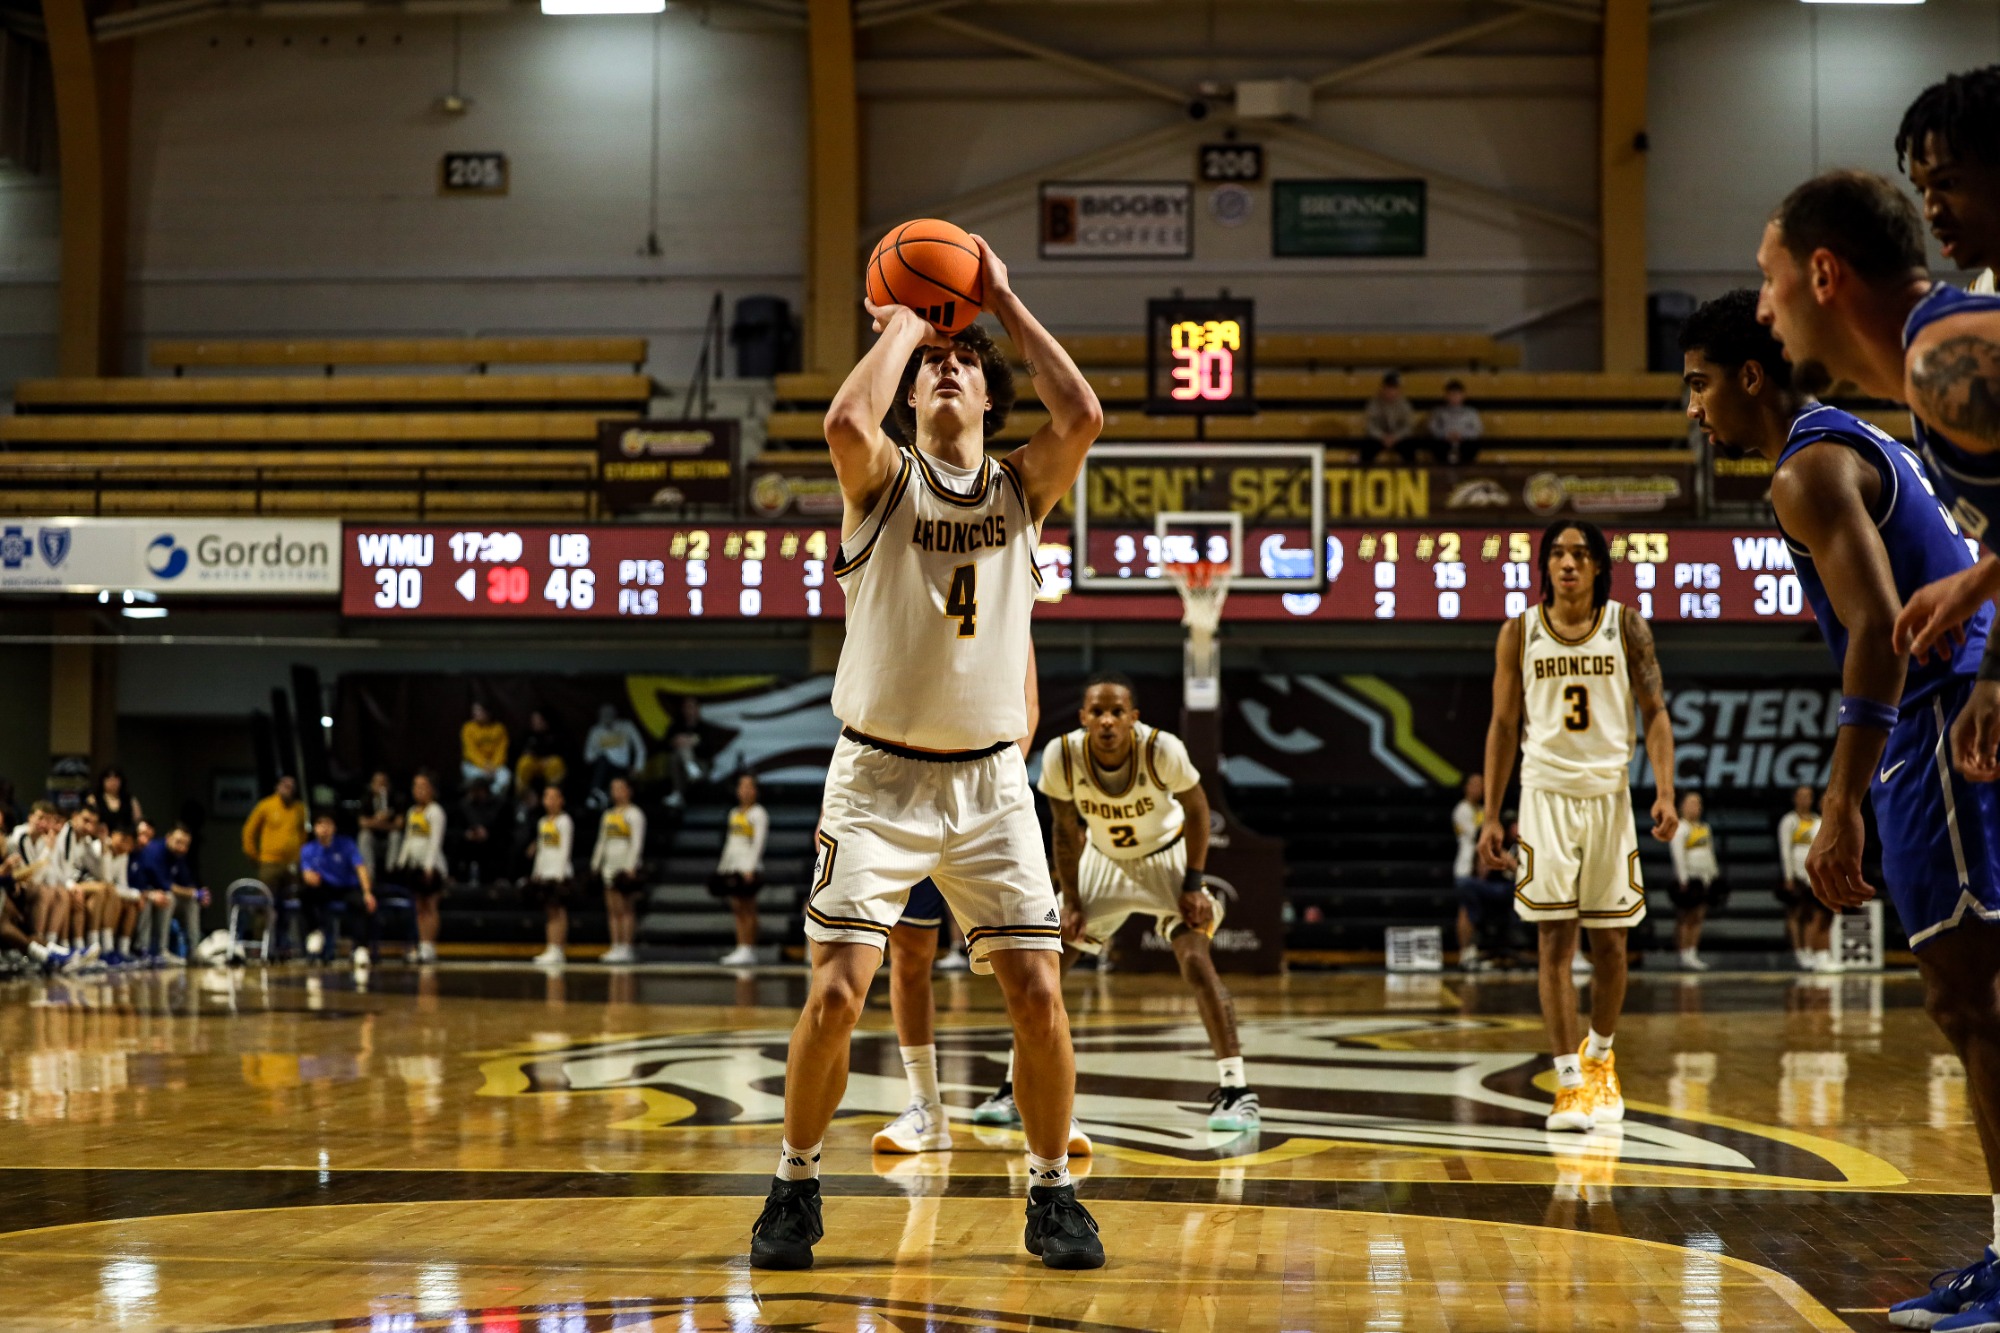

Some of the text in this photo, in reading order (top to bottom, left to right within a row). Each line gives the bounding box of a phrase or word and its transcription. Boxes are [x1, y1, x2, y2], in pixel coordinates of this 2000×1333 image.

[449, 159, 500, 185] 205
[1081, 195, 1184, 216] BIGGBY
[1300, 194, 1418, 215] BRONSON
[1080, 227, 1185, 247] COFFEE
[1172, 347, 1233, 400] 30
[197, 534, 328, 567] Gordon
[358, 534, 434, 566] WMU
[550, 534, 590, 567] UB
[1609, 533, 1669, 563] #33
[1732, 537, 1796, 571] WM
[374, 566, 596, 610] 30 30 46
[686, 560, 708, 586] 5
[803, 560, 825, 587] 3
[1433, 561, 1467, 589] 15
[1502, 561, 1532, 589] 11
[1674, 563, 1721, 589] PTS
[687, 589, 704, 616] 1
[740, 589, 762, 616] 0
[805, 589, 823, 616] 1
[944, 560, 979, 640] 4
[1374, 591, 1396, 620] 2
[1438, 591, 1460, 619] 0
[1505, 591, 1527, 619] 0
[1637, 592, 1654, 619] 1
[1753, 574, 1803, 616] 30
[1533, 655, 1615, 681] BRONCOS
[1563, 684, 1591, 734] 3
[1108, 824, 1140, 848] 2
